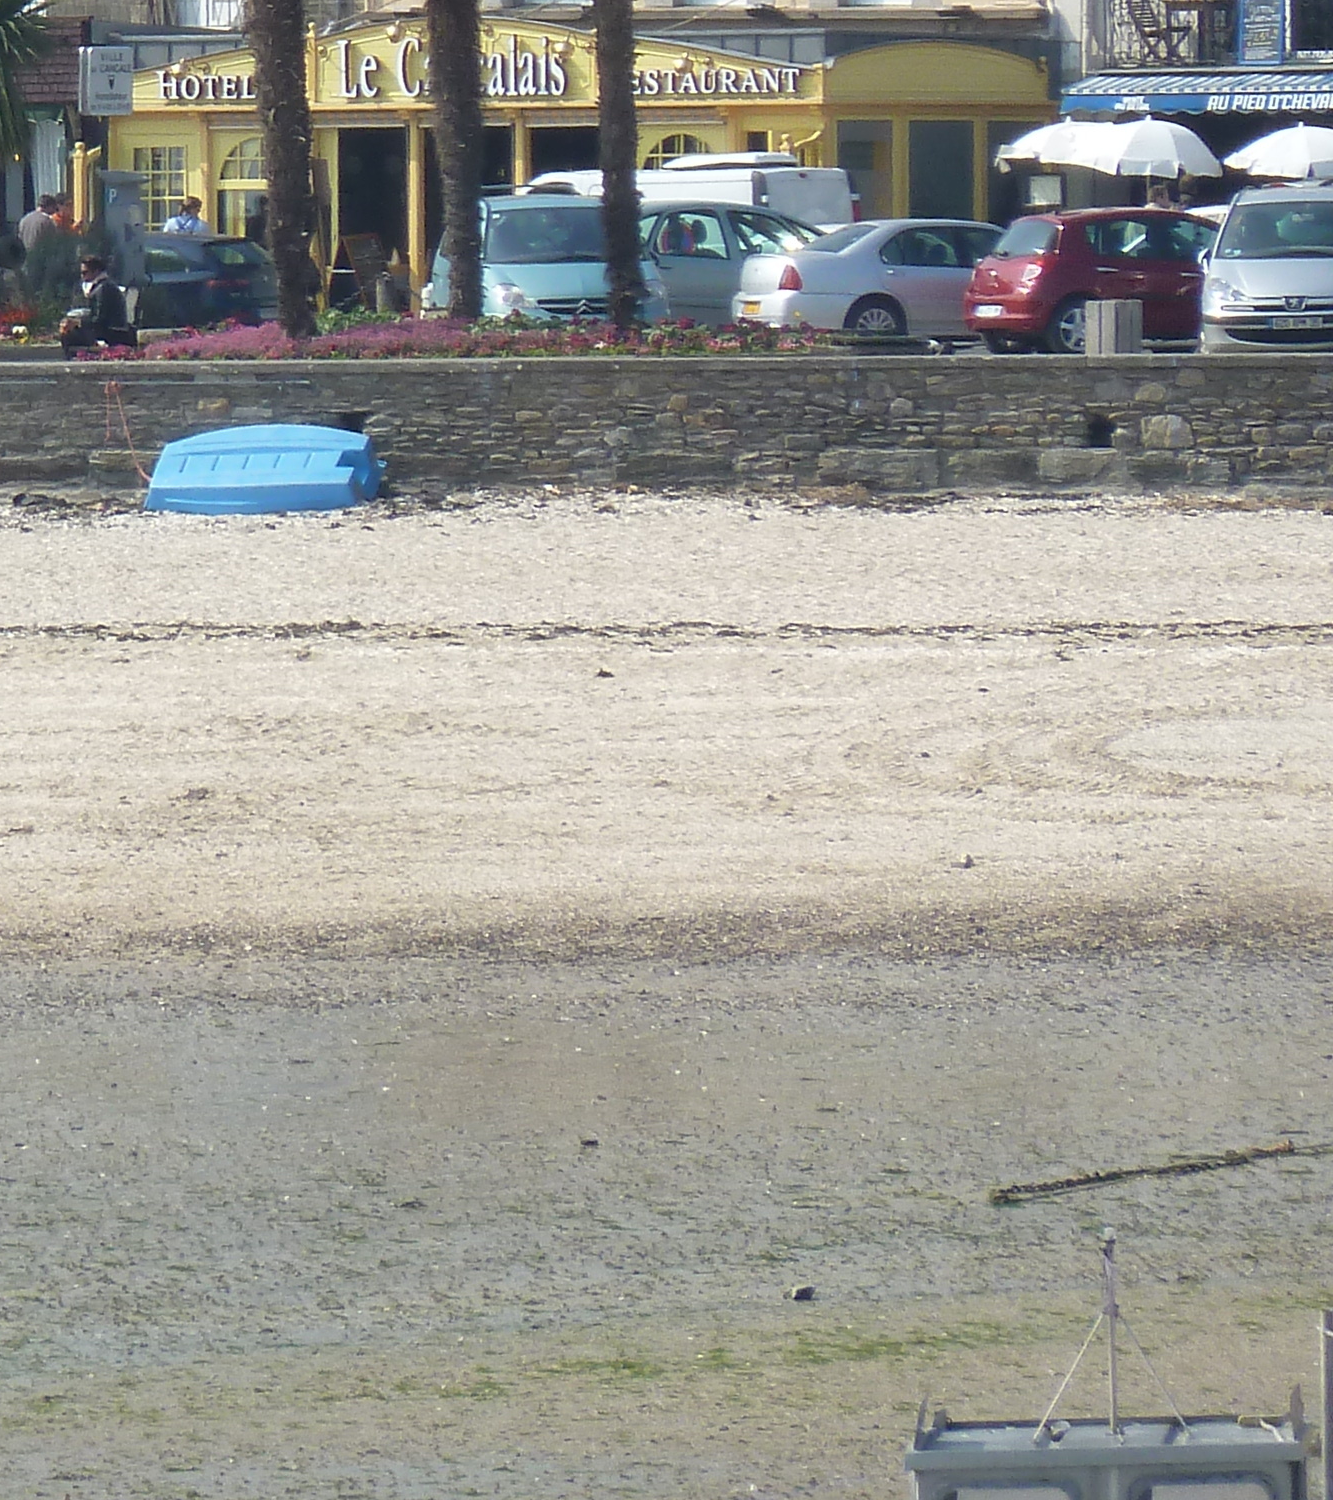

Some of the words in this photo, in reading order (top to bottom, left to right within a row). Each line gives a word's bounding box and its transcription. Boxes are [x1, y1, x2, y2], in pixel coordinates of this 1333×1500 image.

[336, 39, 379, 99] Le
[397, 34, 567, 98] Calais
[154, 69, 257, 101] HOTEL
[631, 67, 799, 96] ESTAURANT
[1207, 95, 1230, 111] AU
[1231, 94, 1267, 110] PIED
[108, 187, 117, 203] P
